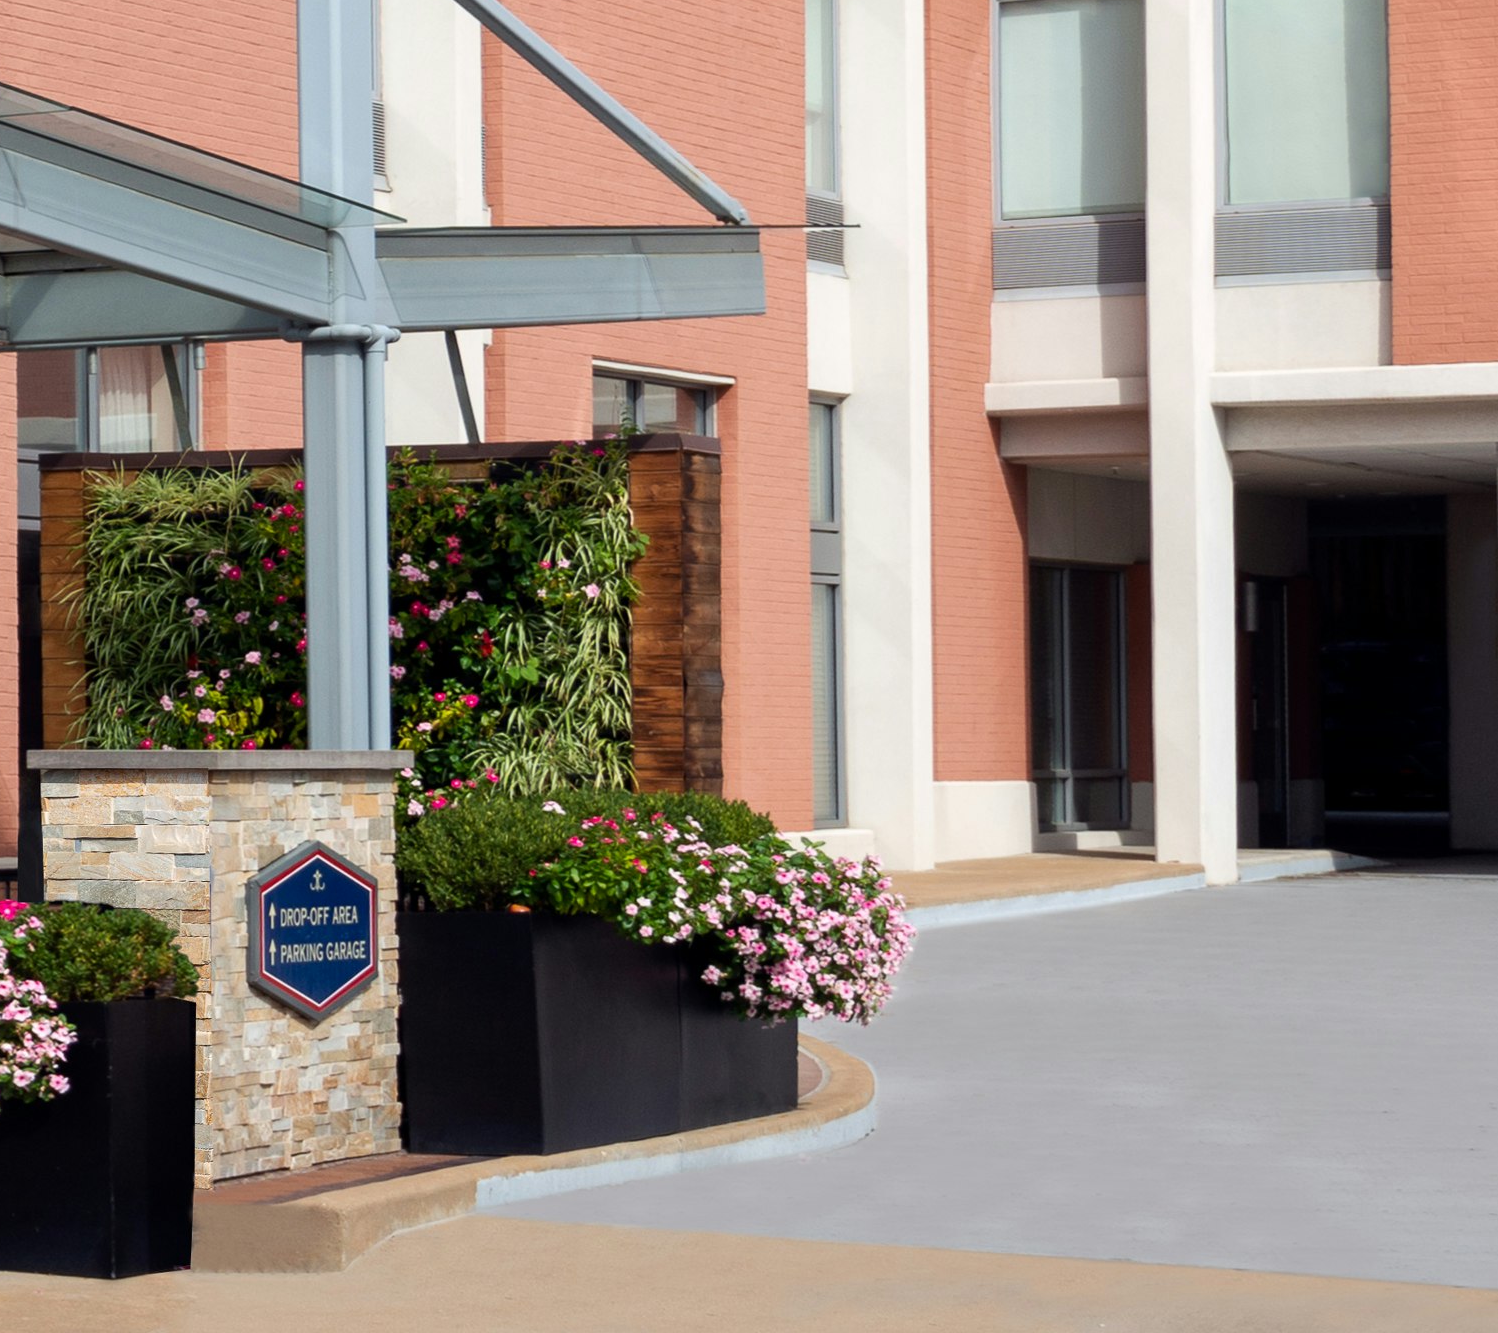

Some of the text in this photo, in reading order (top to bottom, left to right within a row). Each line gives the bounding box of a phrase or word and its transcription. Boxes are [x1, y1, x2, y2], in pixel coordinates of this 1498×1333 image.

[280, 905, 358, 927] DROP-OFF AREA
[280, 940, 366, 963] PARKING GARAGE
